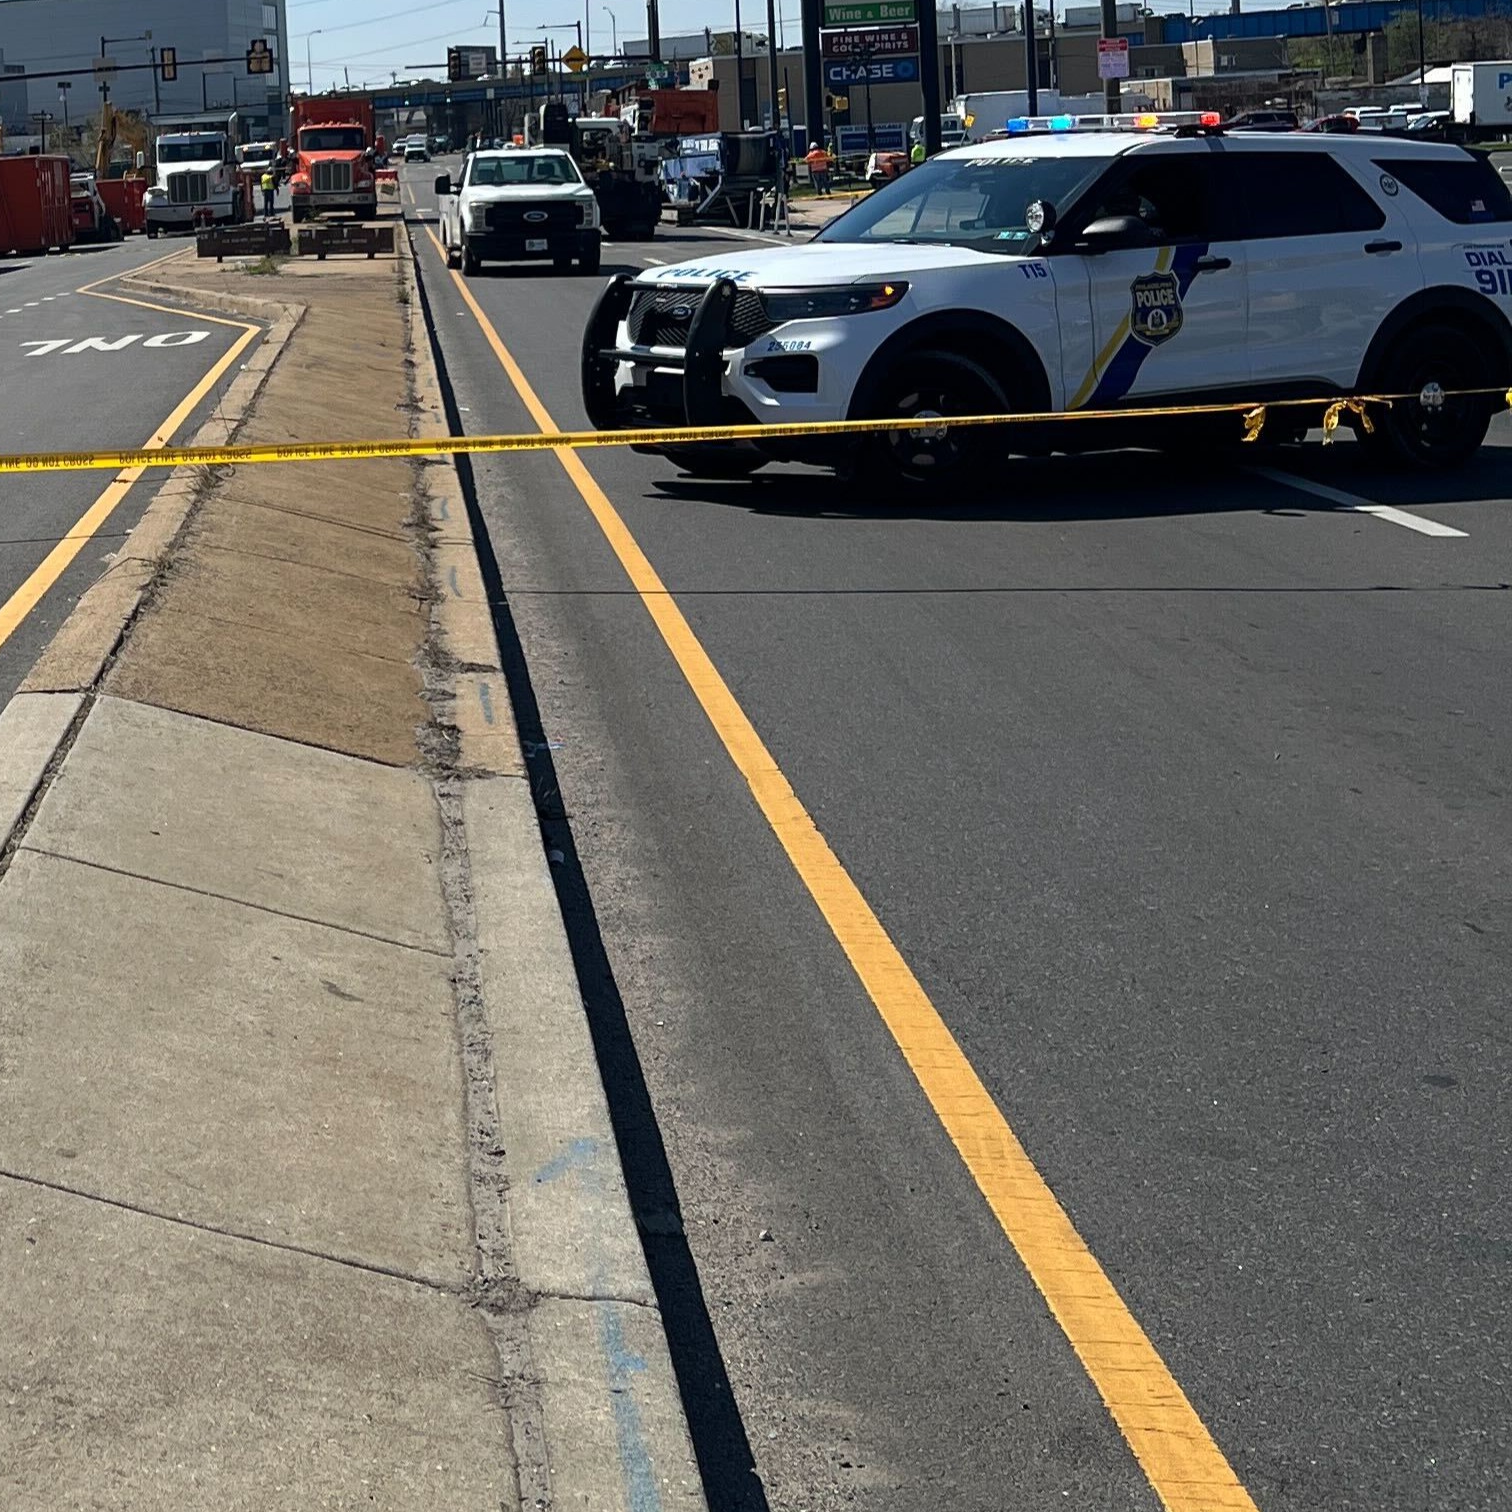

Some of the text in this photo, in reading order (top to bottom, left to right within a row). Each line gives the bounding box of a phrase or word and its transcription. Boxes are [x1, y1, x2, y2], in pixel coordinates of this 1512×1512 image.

[829, 4, 911, 21] Wine & Beer
[832, 35, 860, 44] FINE
[864, 33, 896, 42] WINE
[829, 63, 894, 80] CHASE
[1465, 250, 1512, 267] DIAL
[656, 268, 759, 282] POLICE
[1017, 262, 1048, 279] T15
[1136, 288, 1175, 307] POLICE
